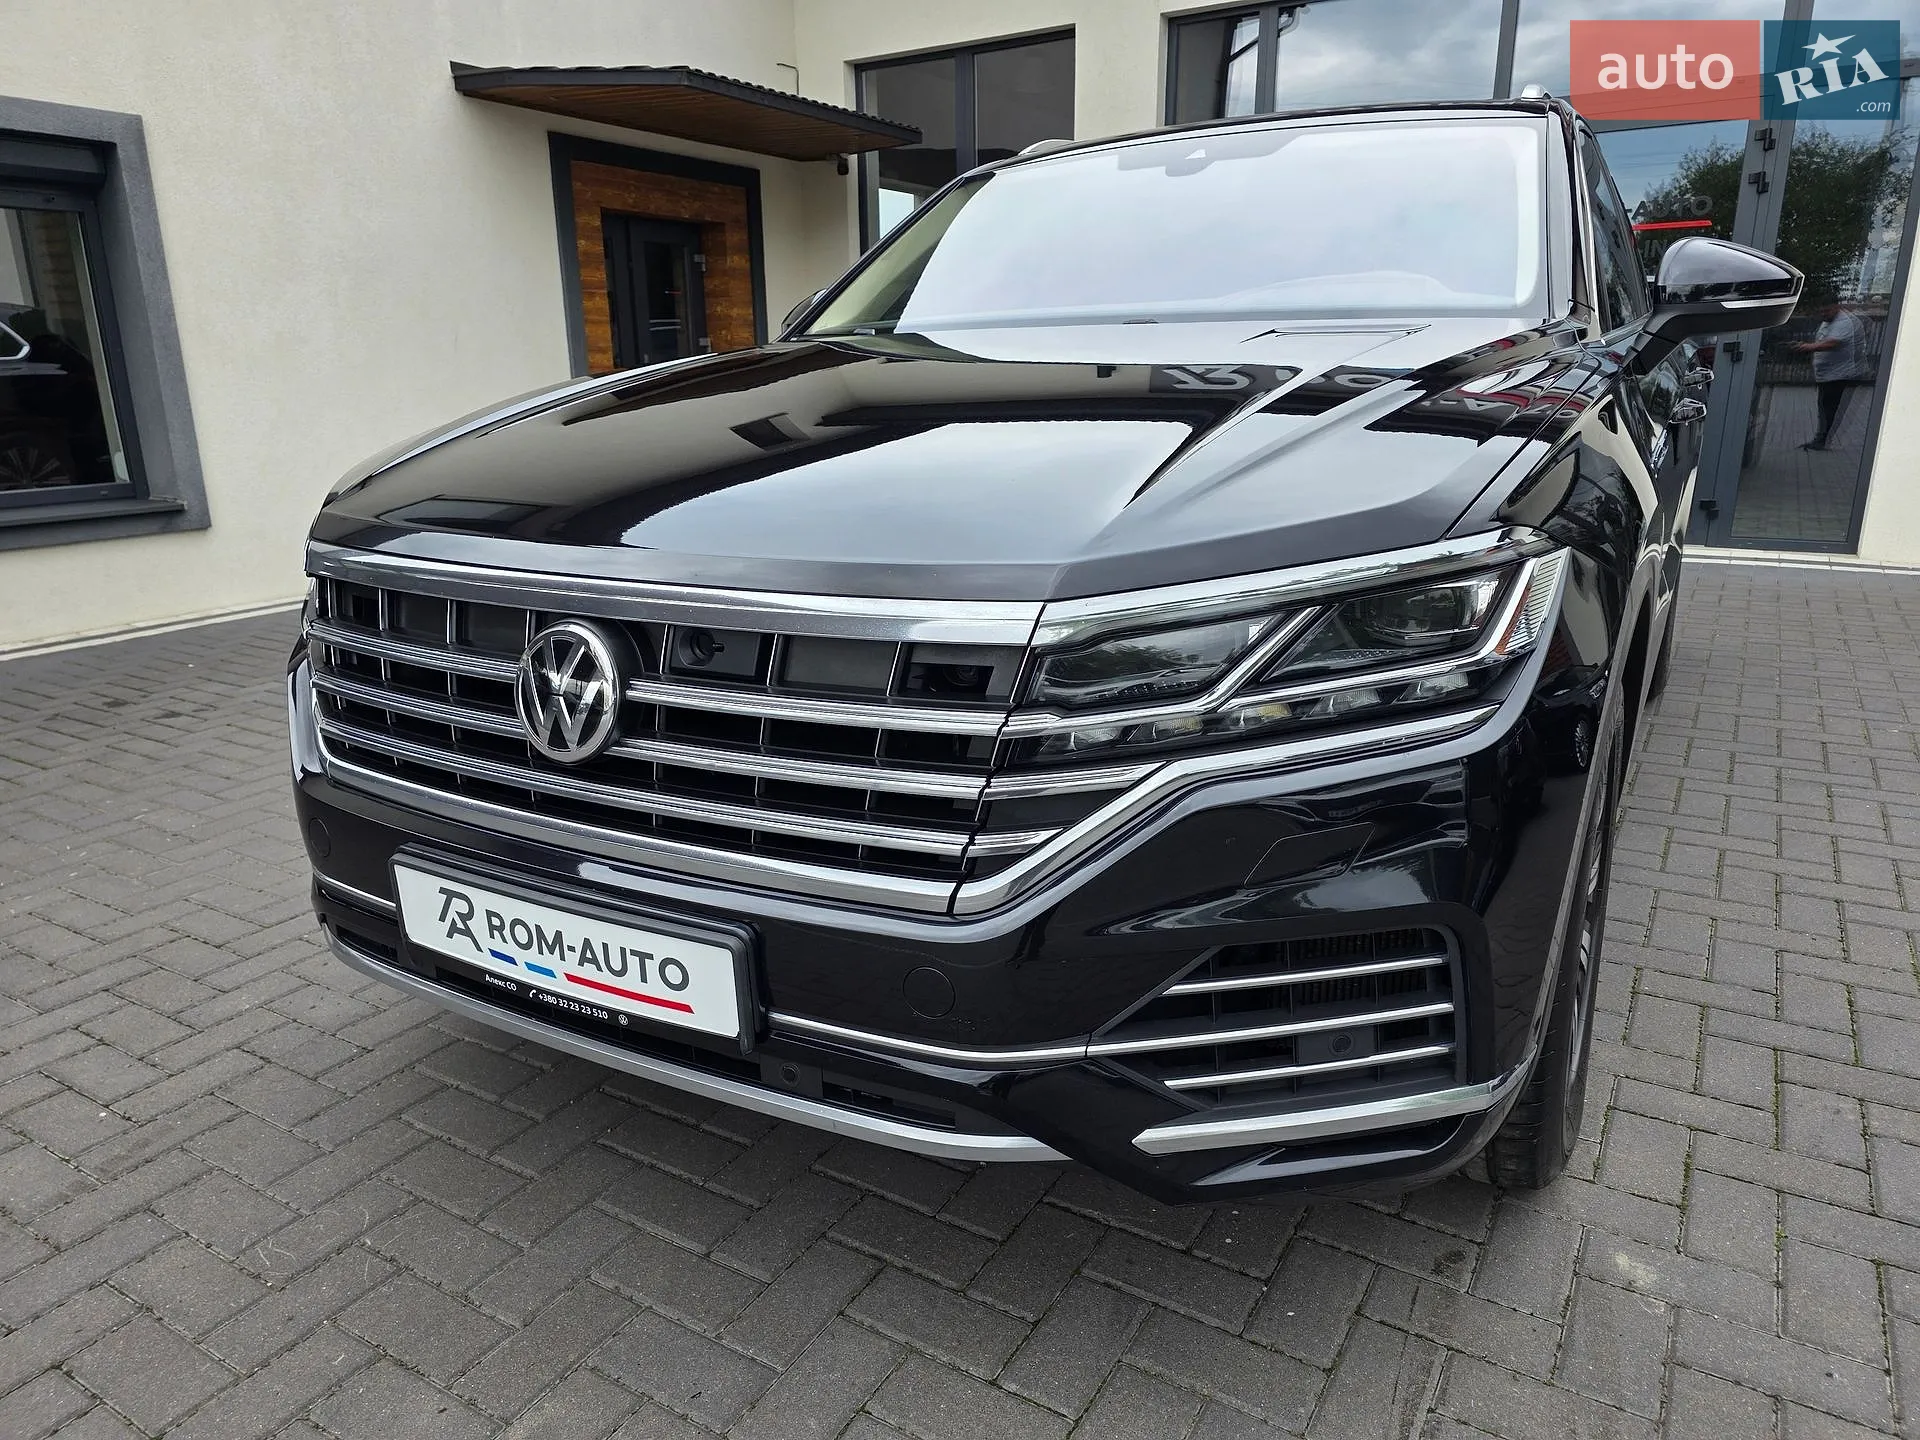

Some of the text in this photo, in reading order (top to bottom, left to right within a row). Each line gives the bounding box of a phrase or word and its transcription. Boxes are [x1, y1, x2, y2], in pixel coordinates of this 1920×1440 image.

[485, 908, 690, 992] ROM-AUTO
[538, 993, 608, 1020] +380 32 23 23 510
